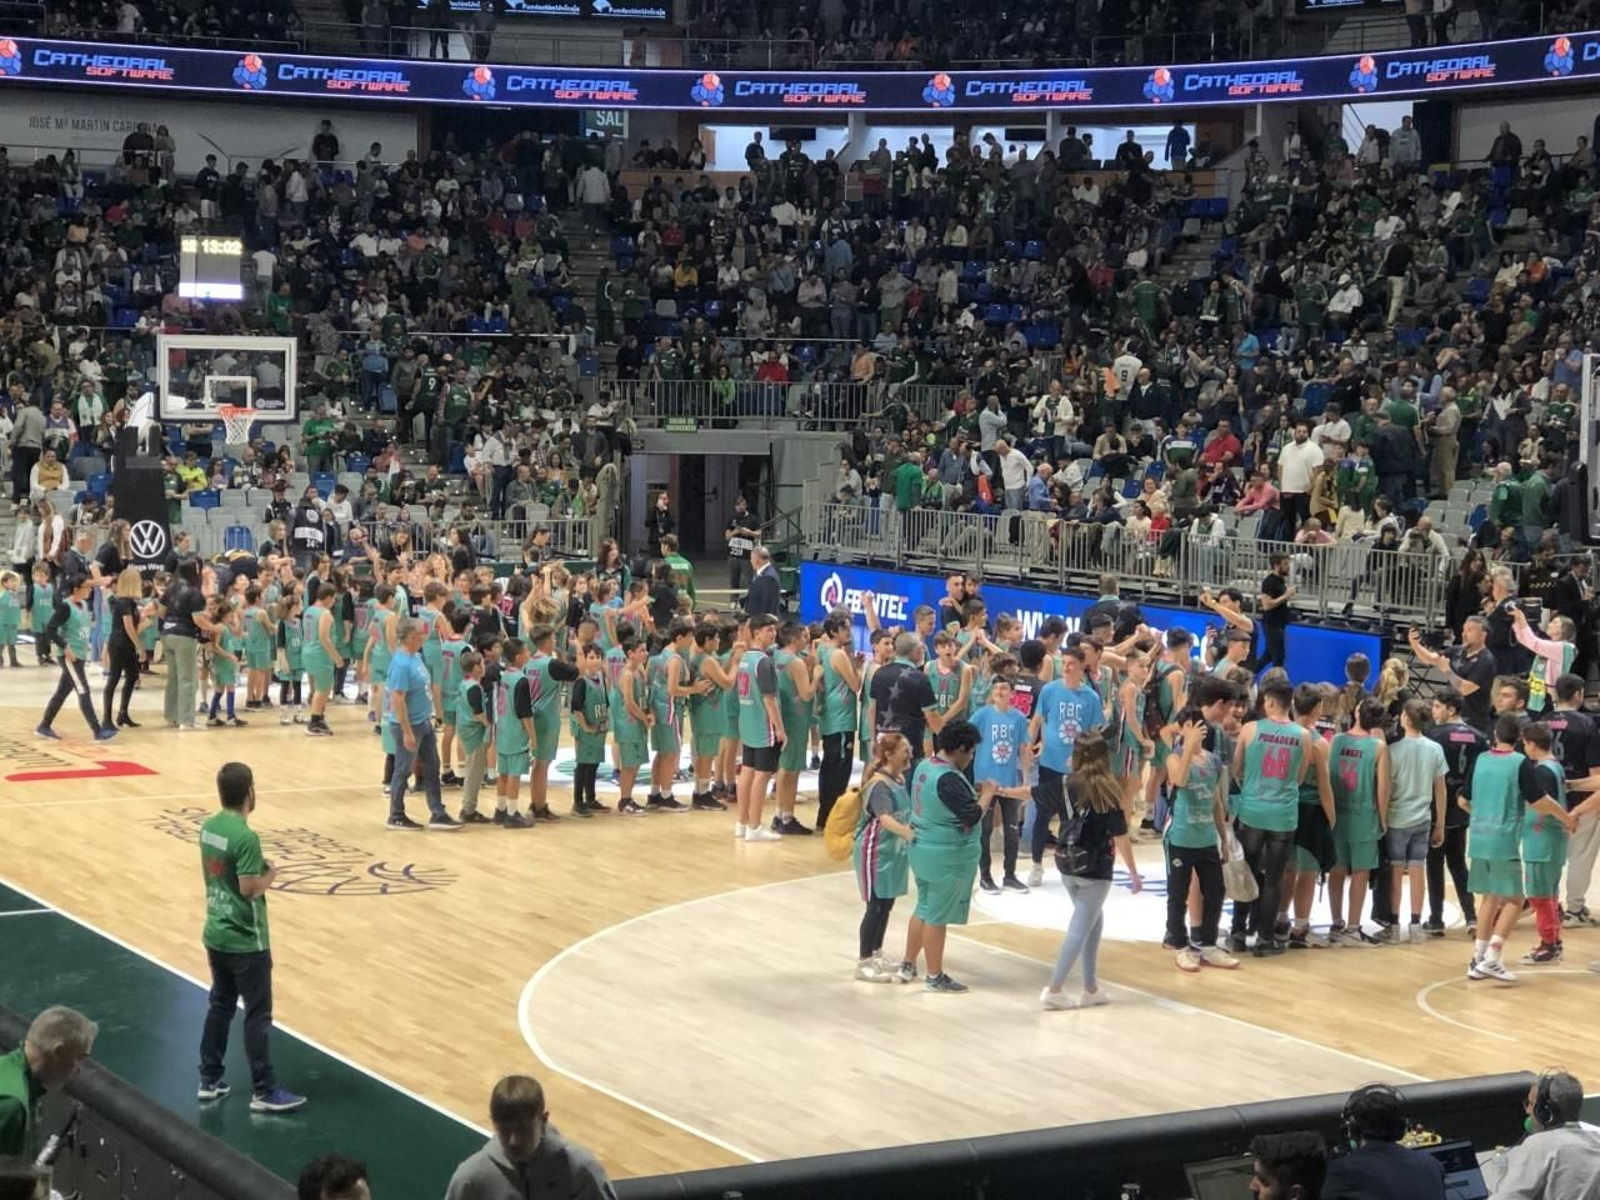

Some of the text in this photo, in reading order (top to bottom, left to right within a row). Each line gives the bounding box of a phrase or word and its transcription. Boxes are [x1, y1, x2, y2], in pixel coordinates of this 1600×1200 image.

[86, 66, 173, 80] SOFTWARE
[1426, 68, 1496, 82] SOFTWARE
[327, 79, 410, 92] SOFTWARE
[1228, 83, 1303, 95] SOFTWARE
[554, 89, 637, 100] SOFTWARE
[783, 93, 865, 103] SOFTWARE
[1012, 91, 1092, 102] SOFTWARE
[201, 239, 242, 255] 13:02
[1059, 701, 1083, 721] RBC
